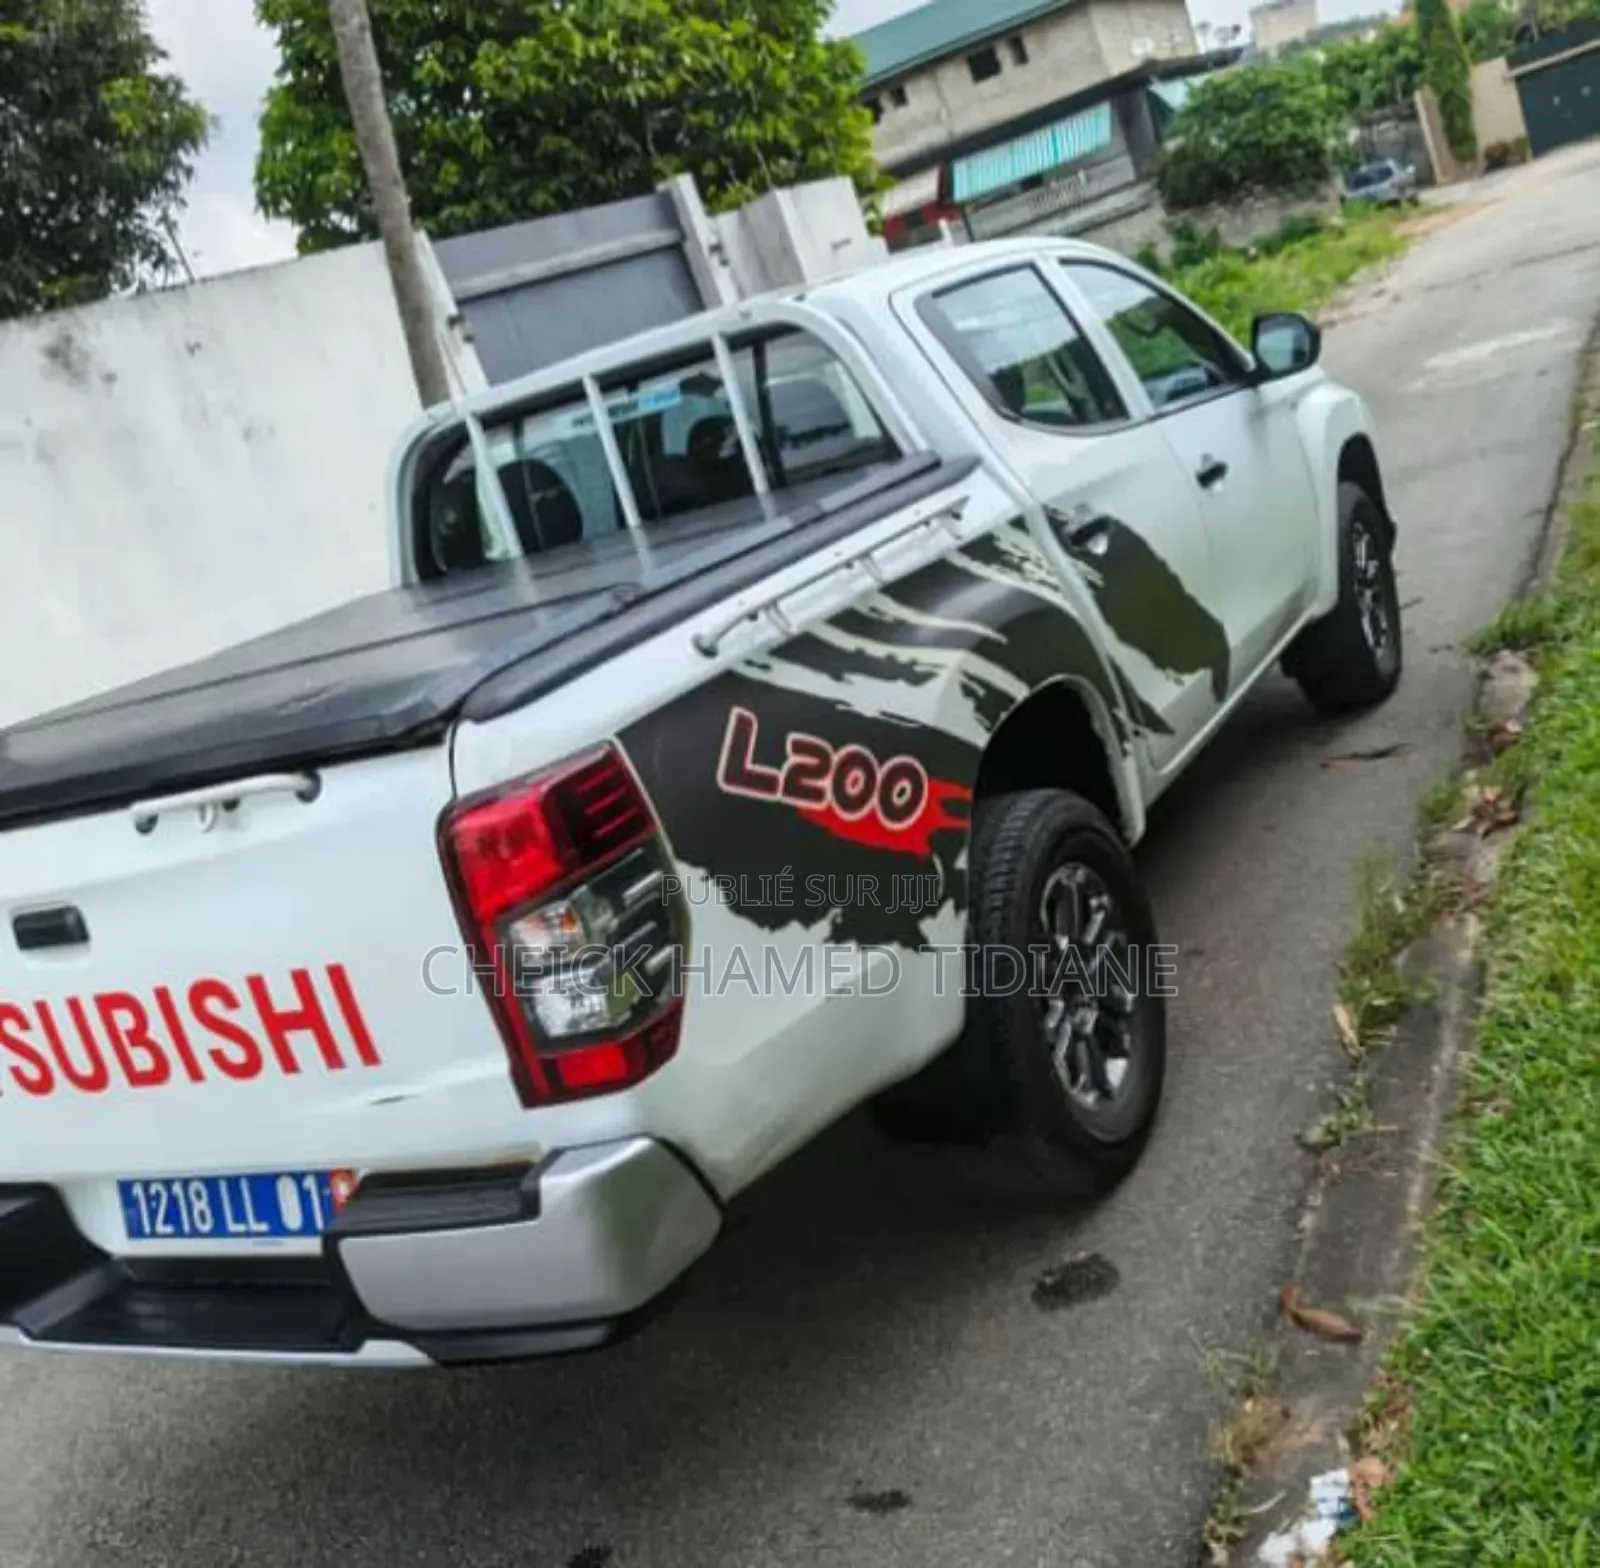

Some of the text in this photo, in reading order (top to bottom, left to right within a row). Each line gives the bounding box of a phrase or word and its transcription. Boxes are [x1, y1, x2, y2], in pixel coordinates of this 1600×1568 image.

[716, 706, 928, 831] L200
[132, 1180, 213, 1235] 1218
[218, 1175, 270, 1233] LL
